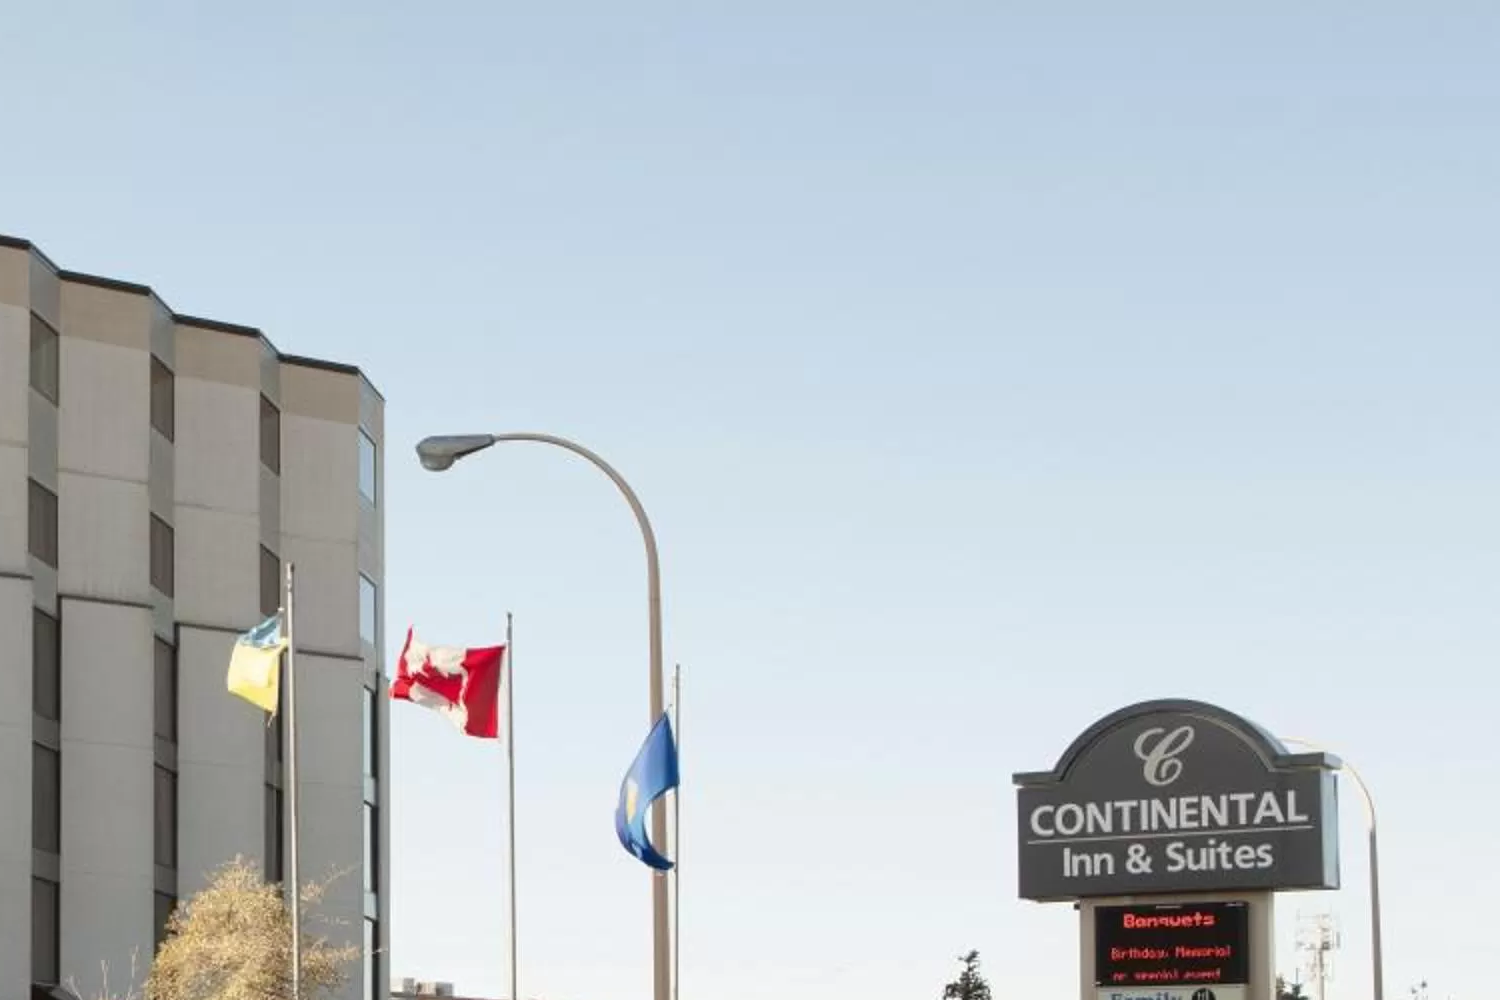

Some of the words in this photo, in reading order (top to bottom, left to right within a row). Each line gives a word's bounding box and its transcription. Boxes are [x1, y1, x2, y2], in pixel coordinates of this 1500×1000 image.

[1030, 789, 1309, 837] CONTINENTAL
[1062, 846, 1115, 878] Inn
[1125, 843, 1153, 874] &
[1165, 838, 1274, 872] Suites
[1123, 911, 1216, 929] Banquets
